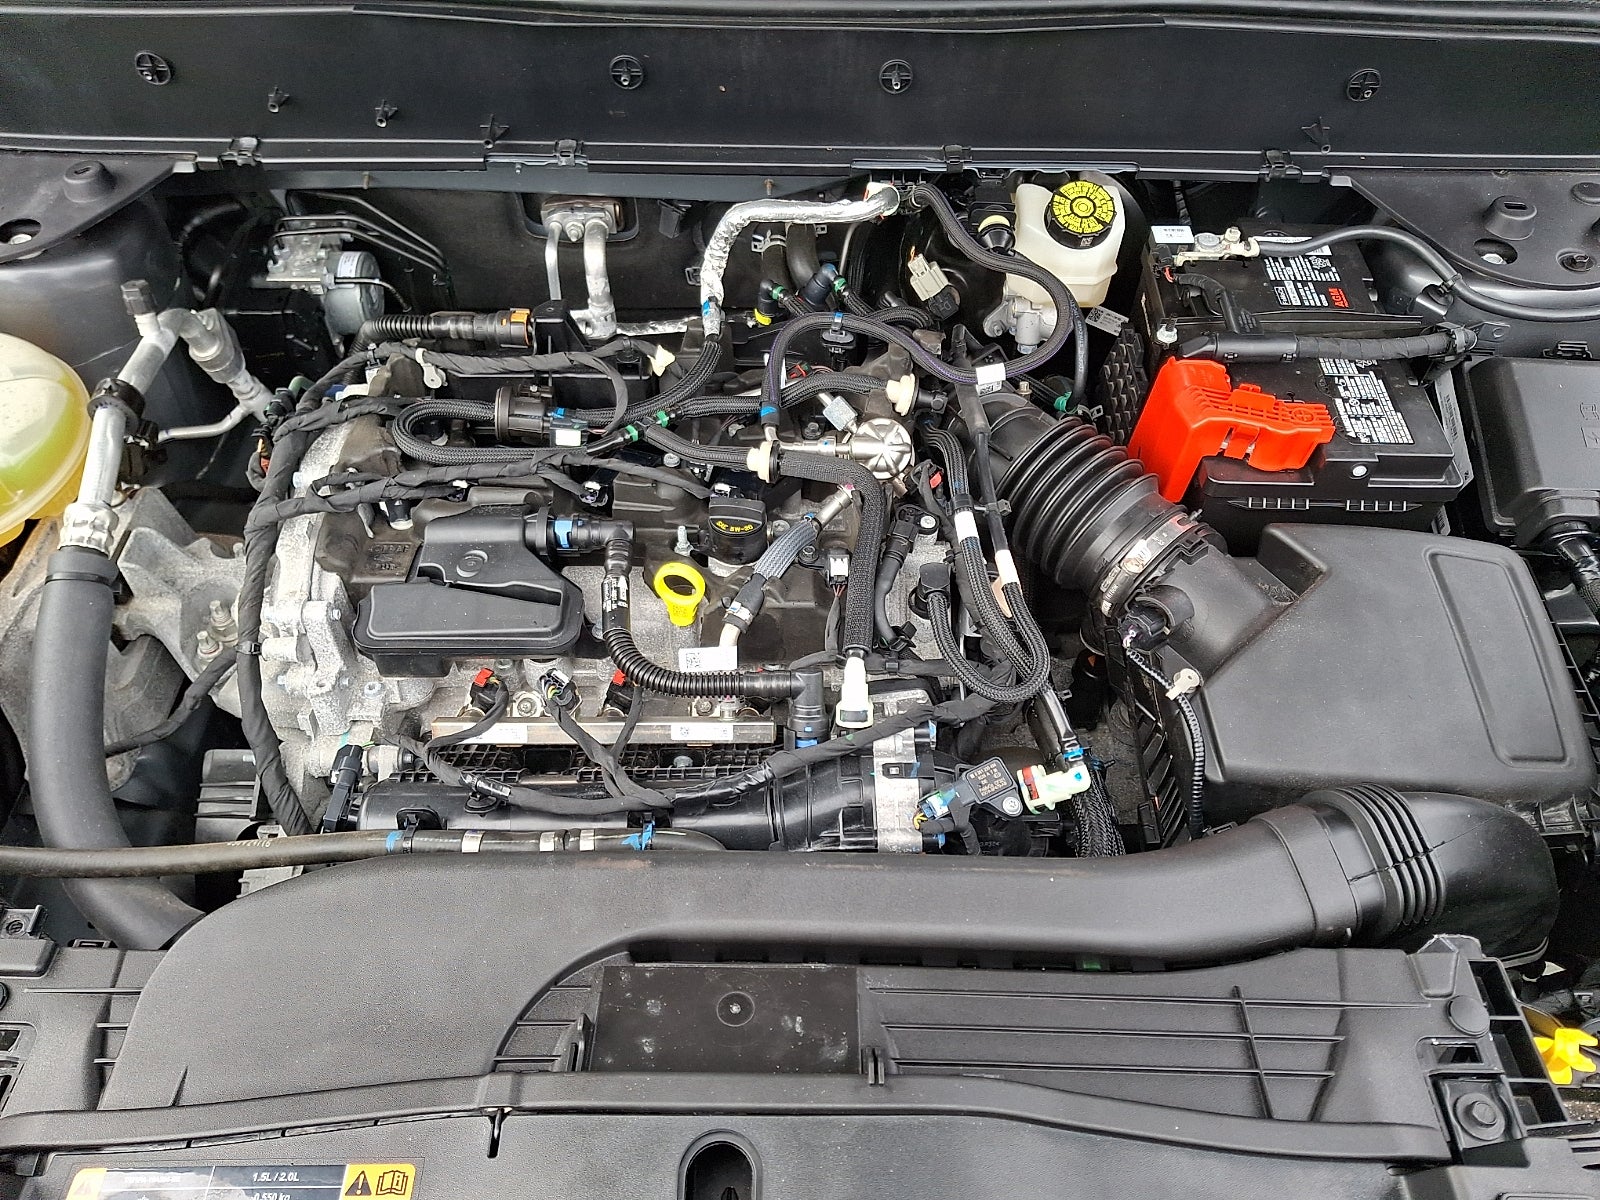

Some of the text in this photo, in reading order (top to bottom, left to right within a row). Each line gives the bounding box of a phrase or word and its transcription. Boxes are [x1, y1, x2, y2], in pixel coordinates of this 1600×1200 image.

[1329, 288, 1345, 307] AGM
[253, 1172, 272, 1182] 1.5L
[279, 1172, 300, 1182] 2.0L
